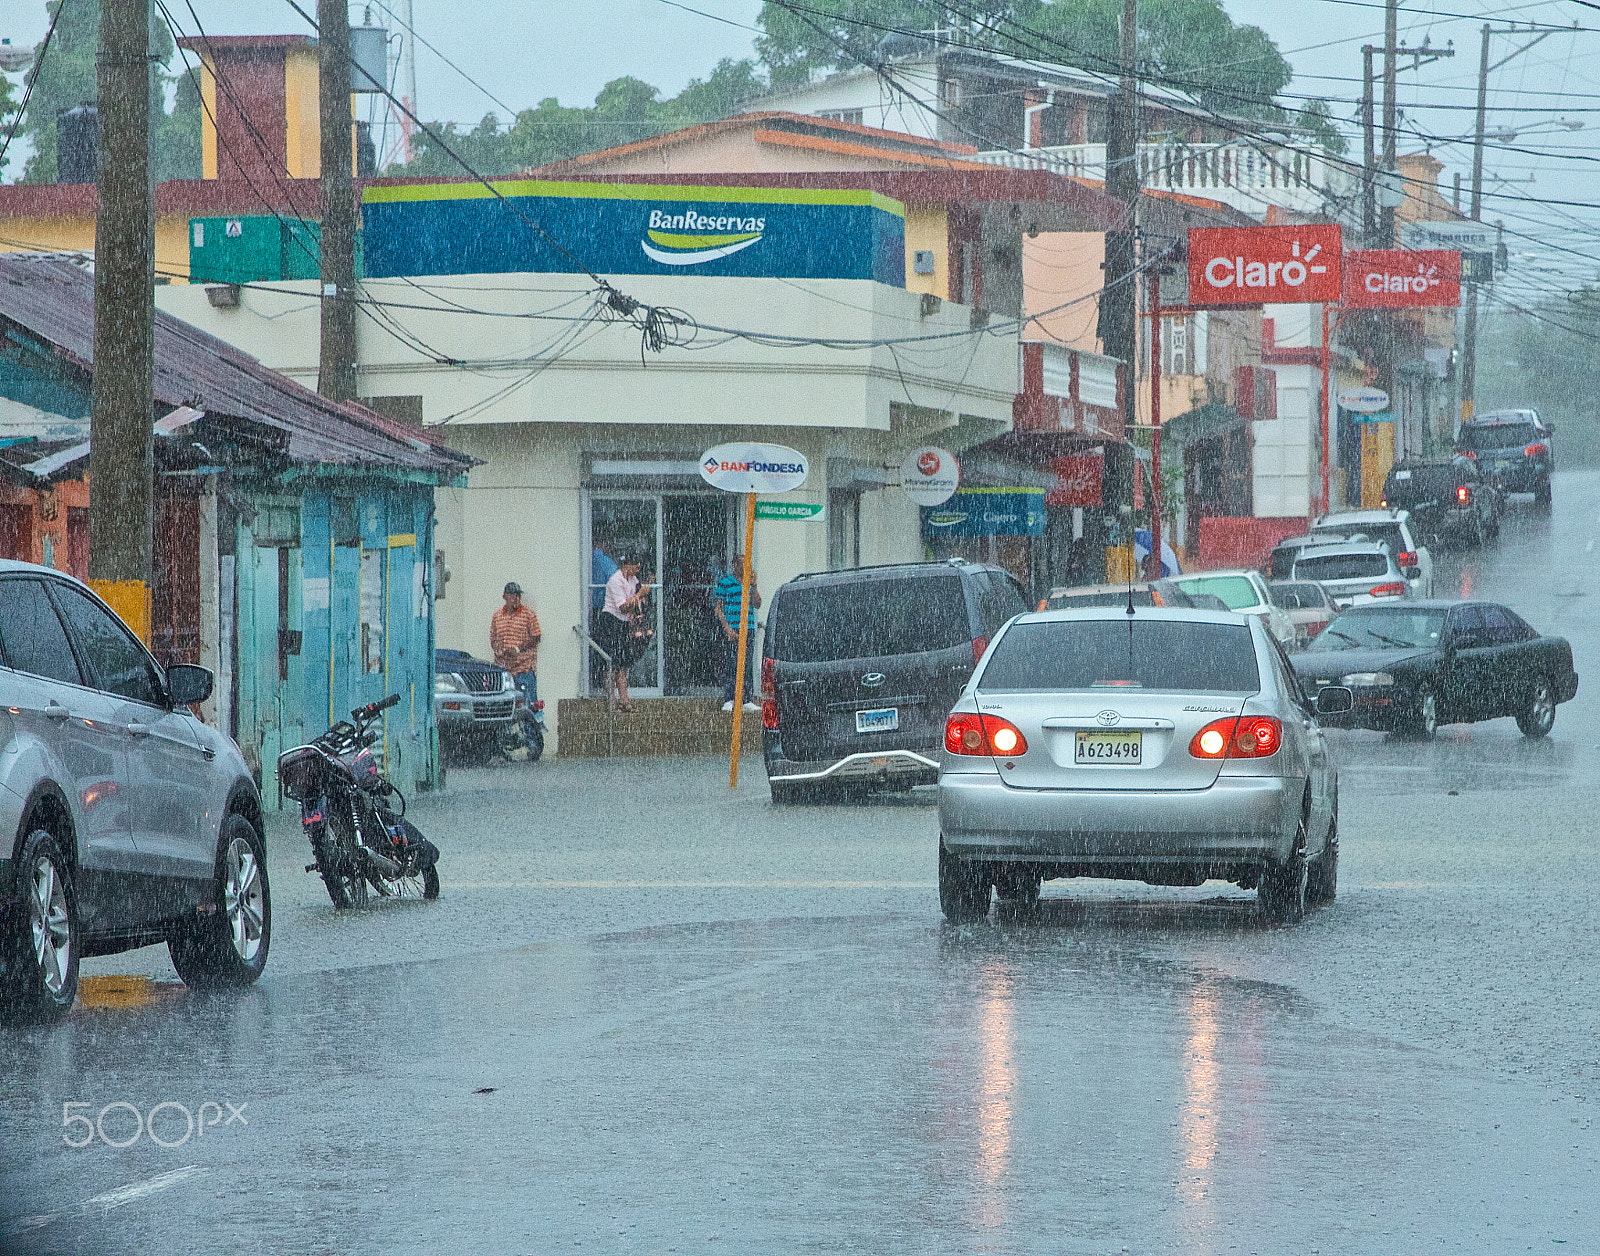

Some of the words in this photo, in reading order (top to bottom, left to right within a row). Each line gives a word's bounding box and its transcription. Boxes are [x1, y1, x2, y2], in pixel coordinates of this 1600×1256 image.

[648, 209, 766, 231] BanReservas
[1204, 255, 1308, 288] Claro
[1364, 271, 1430, 293] Claro
[720, 461, 805, 474] BANFONDESA
[759, 505, 787, 515] VIRGILIO
[788, 506, 812, 516] GARCIA
[1077, 742, 1139, 758] A623498
